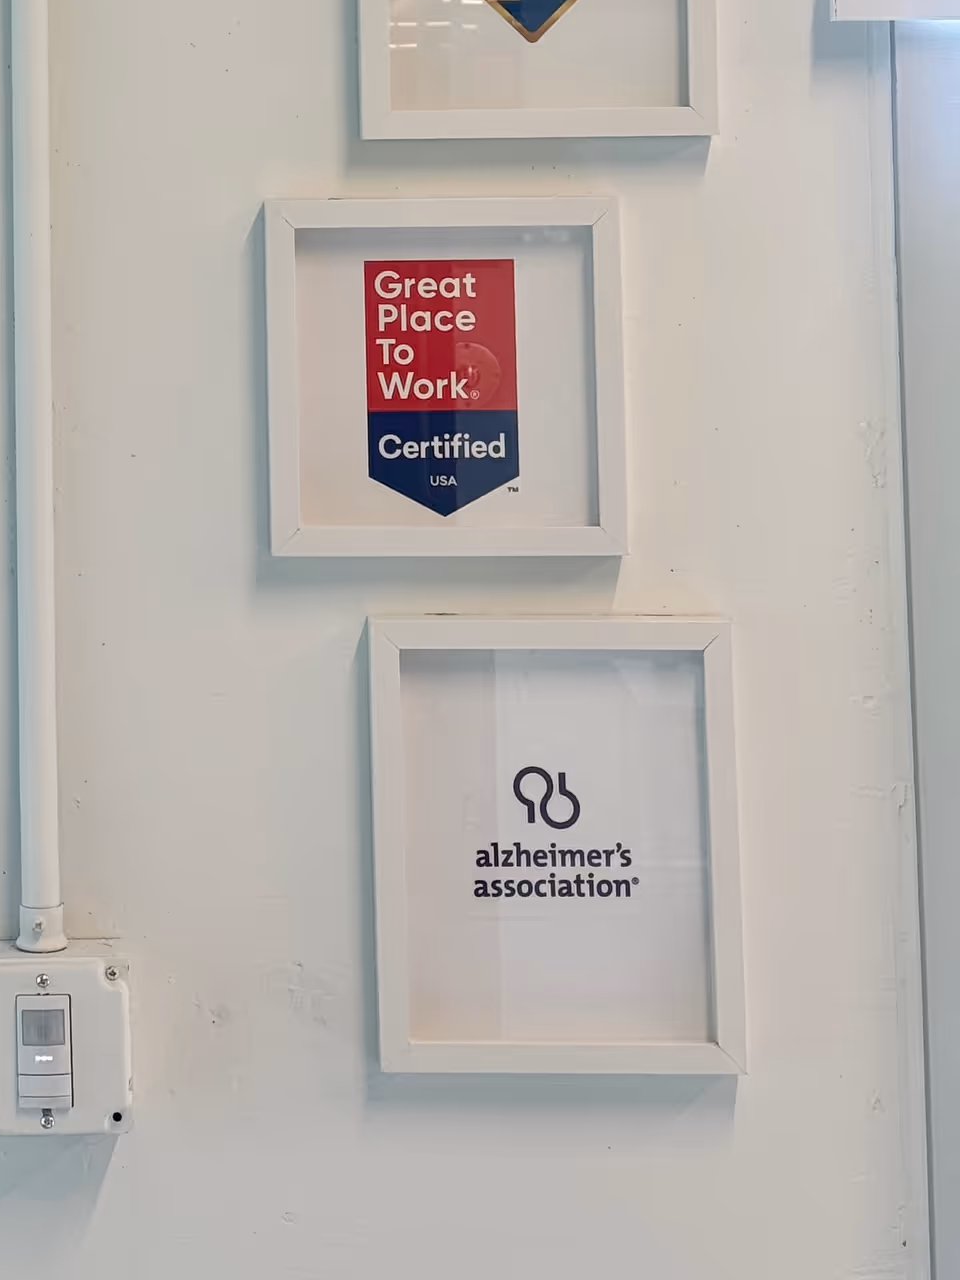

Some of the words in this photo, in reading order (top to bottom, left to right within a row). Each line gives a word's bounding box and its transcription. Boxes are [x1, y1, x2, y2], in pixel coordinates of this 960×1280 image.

[374, 270, 476, 298] Great
[378, 304, 476, 332] Place
[376, 338, 415, 365] To
[378, 433, 506, 459] Certified
[430, 475, 458, 486] USA
[475, 842, 632, 868] alzheimer's
